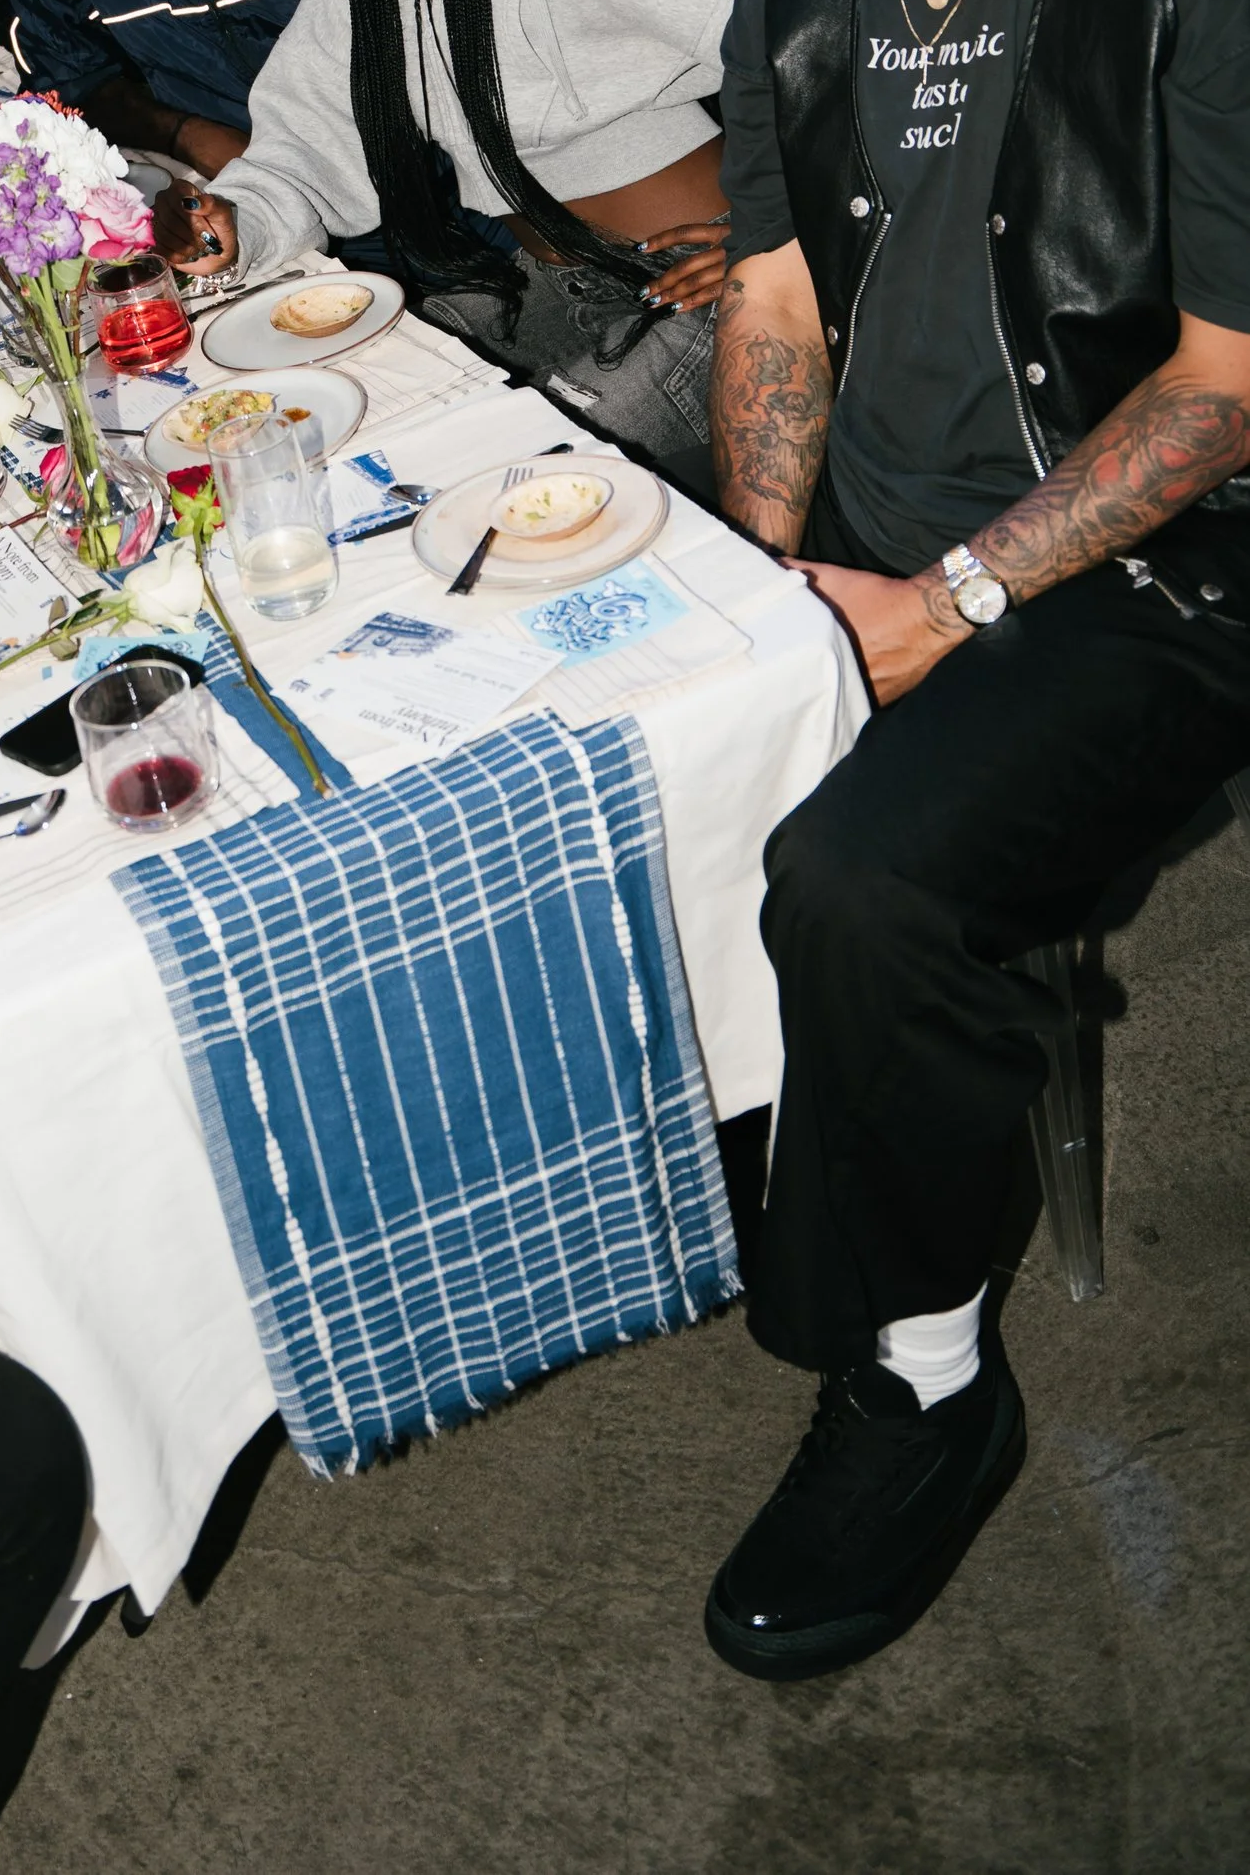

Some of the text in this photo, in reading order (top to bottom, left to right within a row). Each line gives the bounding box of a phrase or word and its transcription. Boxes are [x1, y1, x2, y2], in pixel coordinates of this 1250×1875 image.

[867, 37, 934, 71] Your
[0, 542, 24, 567] Note
[17, 561, 41, 584] from
